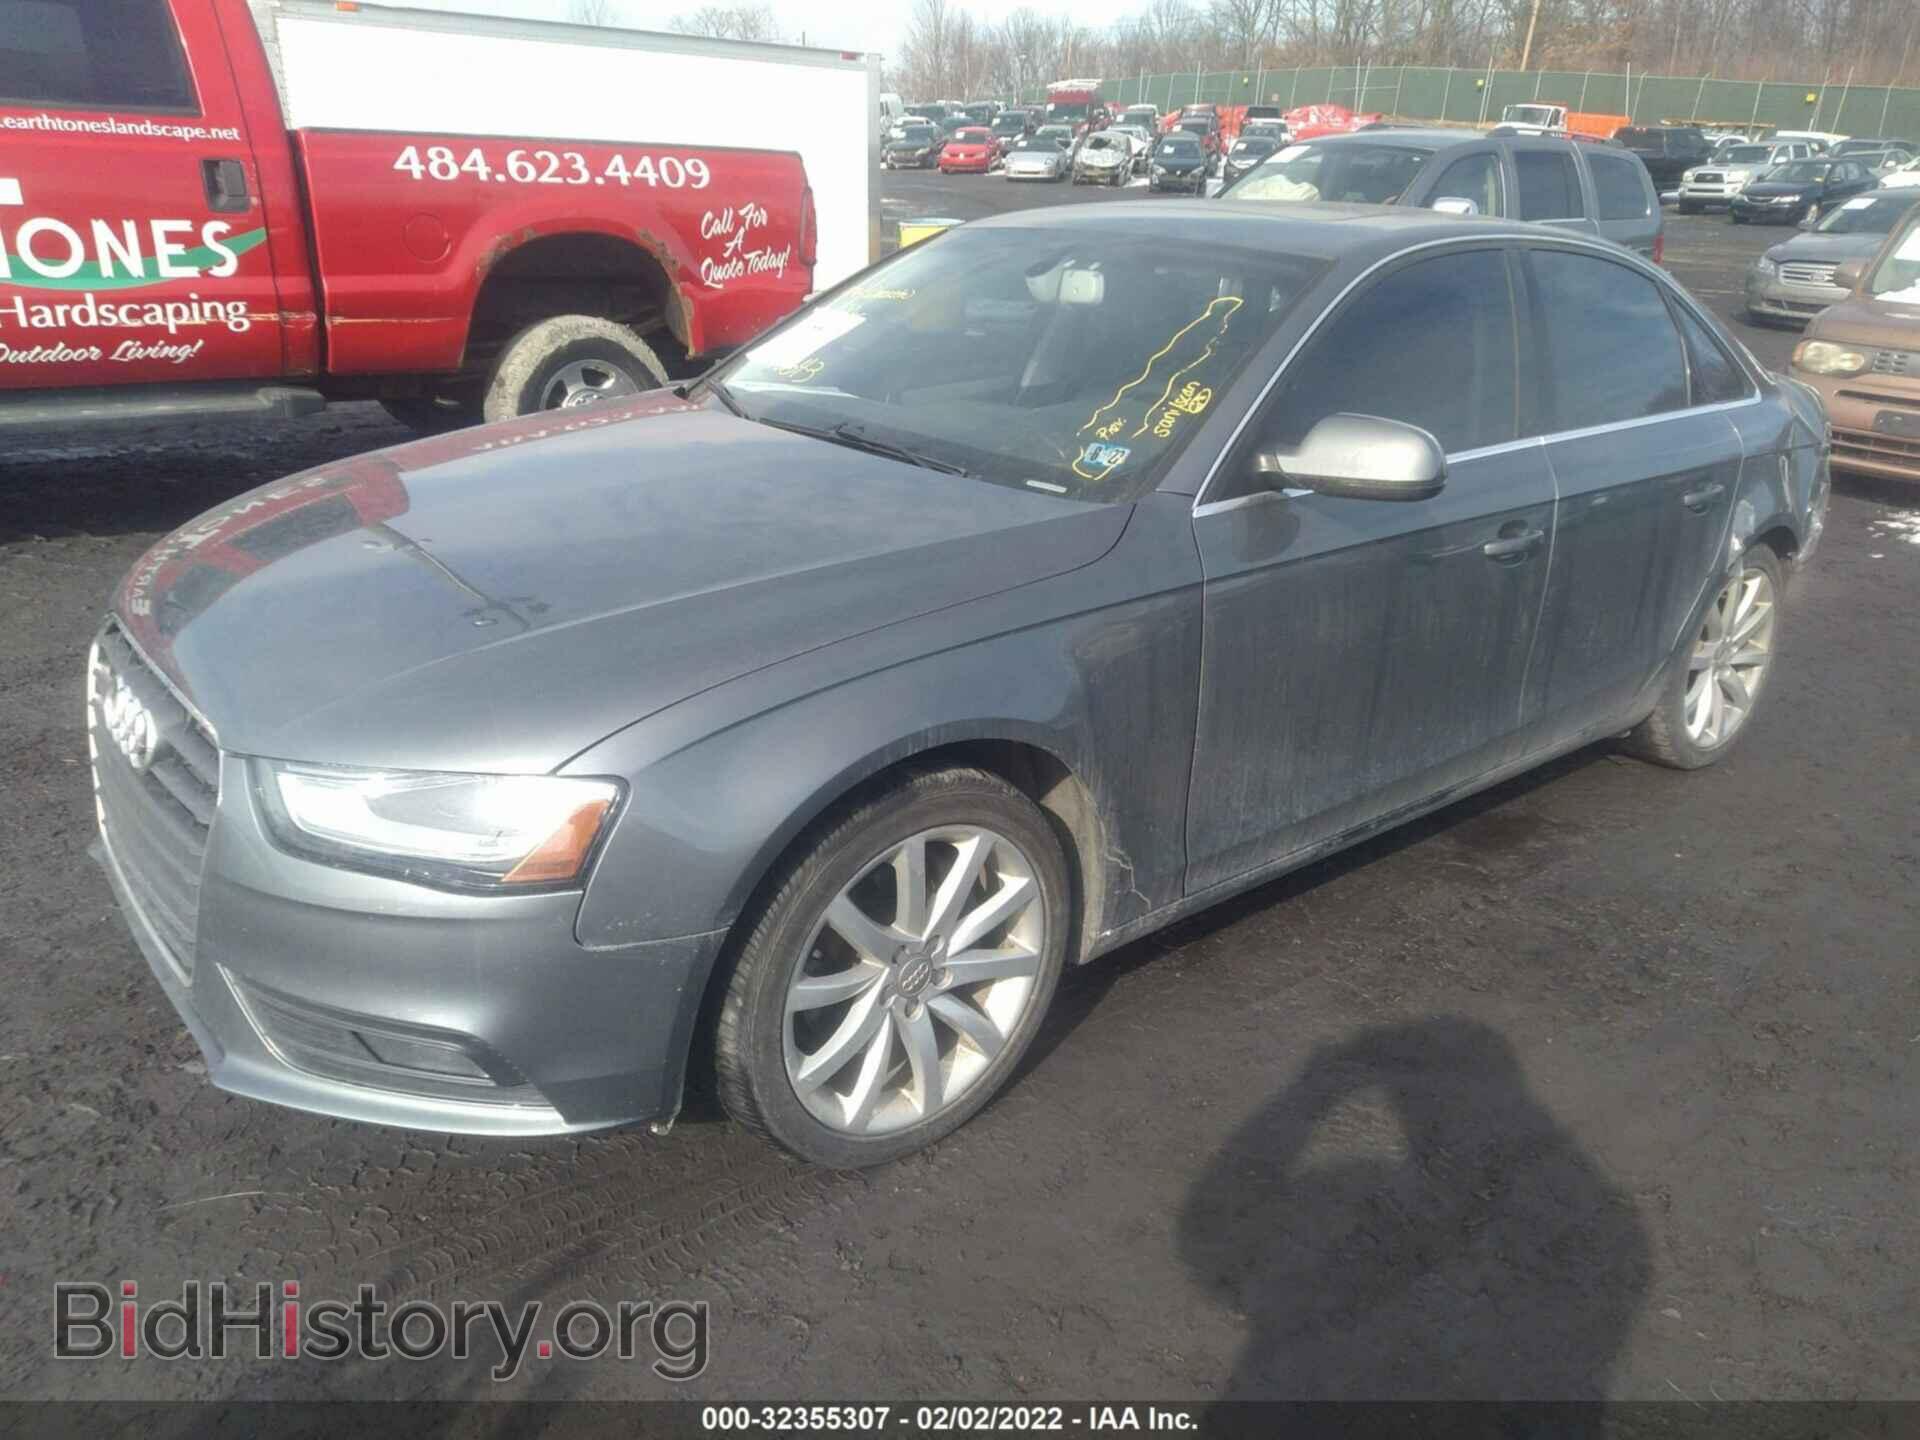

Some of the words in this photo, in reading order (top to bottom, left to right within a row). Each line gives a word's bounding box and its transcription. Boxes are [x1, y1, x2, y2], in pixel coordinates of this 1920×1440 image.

[393, 145, 711, 189] 484.623.4409
[701, 207, 734, 239] Call
[738, 202, 768, 231] For
[723, 226, 744, 258] A
[701, 256, 744, 288] Quote
[743, 242, 791, 279] Today!
[109, 339, 204, 364] Living!
